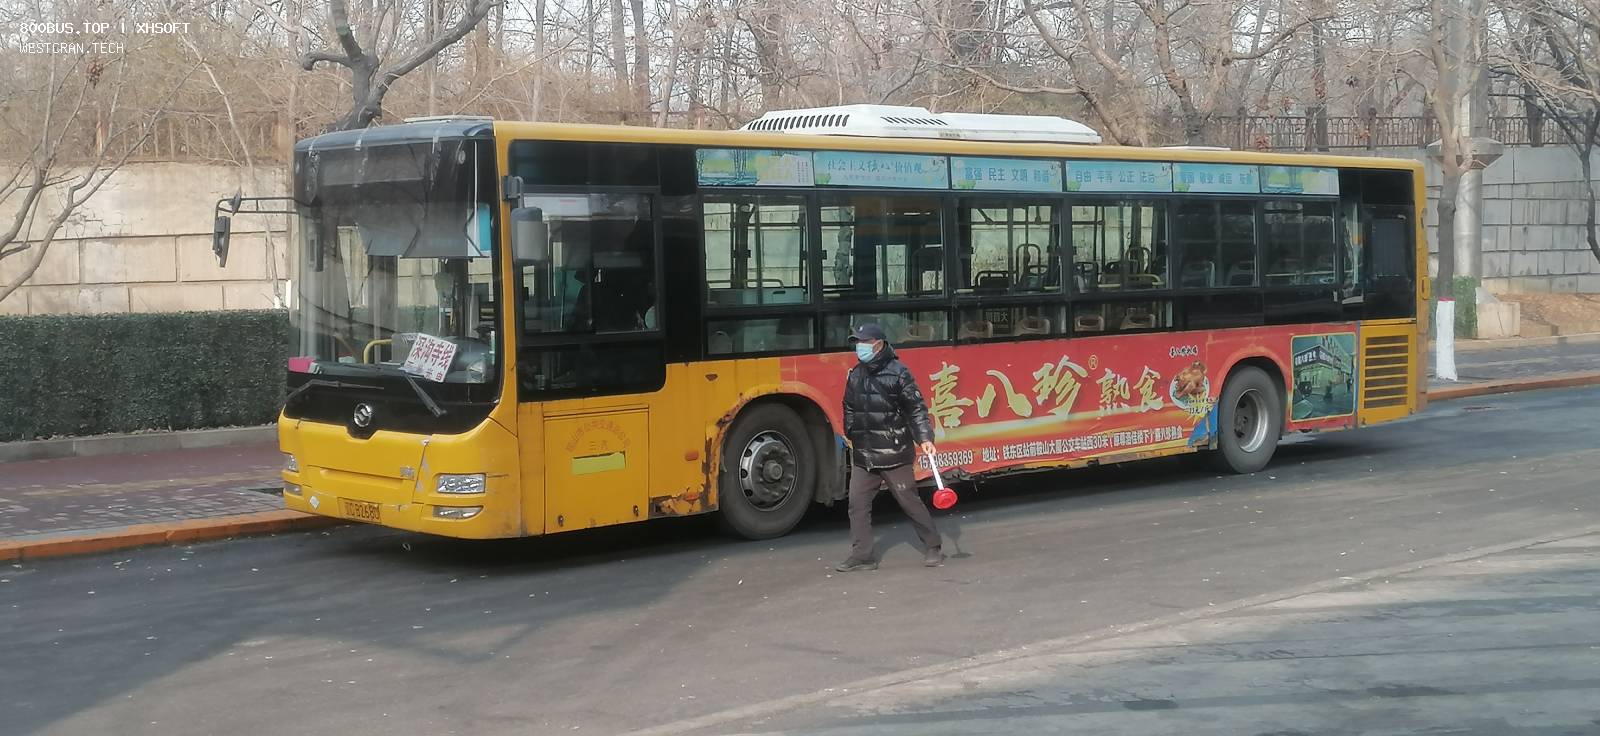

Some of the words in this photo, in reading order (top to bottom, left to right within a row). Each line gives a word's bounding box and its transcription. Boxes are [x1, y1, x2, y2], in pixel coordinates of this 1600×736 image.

[965, 167, 983, 182] 富强
[988, 168, 1006, 182] 民主
[1011, 168, 1029, 183] 文明
[1075, 170, 1092, 184] 自由
[1119, 170, 1135, 184] 公正
[1140, 171, 1156, 184] 法治
[928, 355, 1088, 439] 喜八珍
[1096, 365, 1164, 417] 熟食
